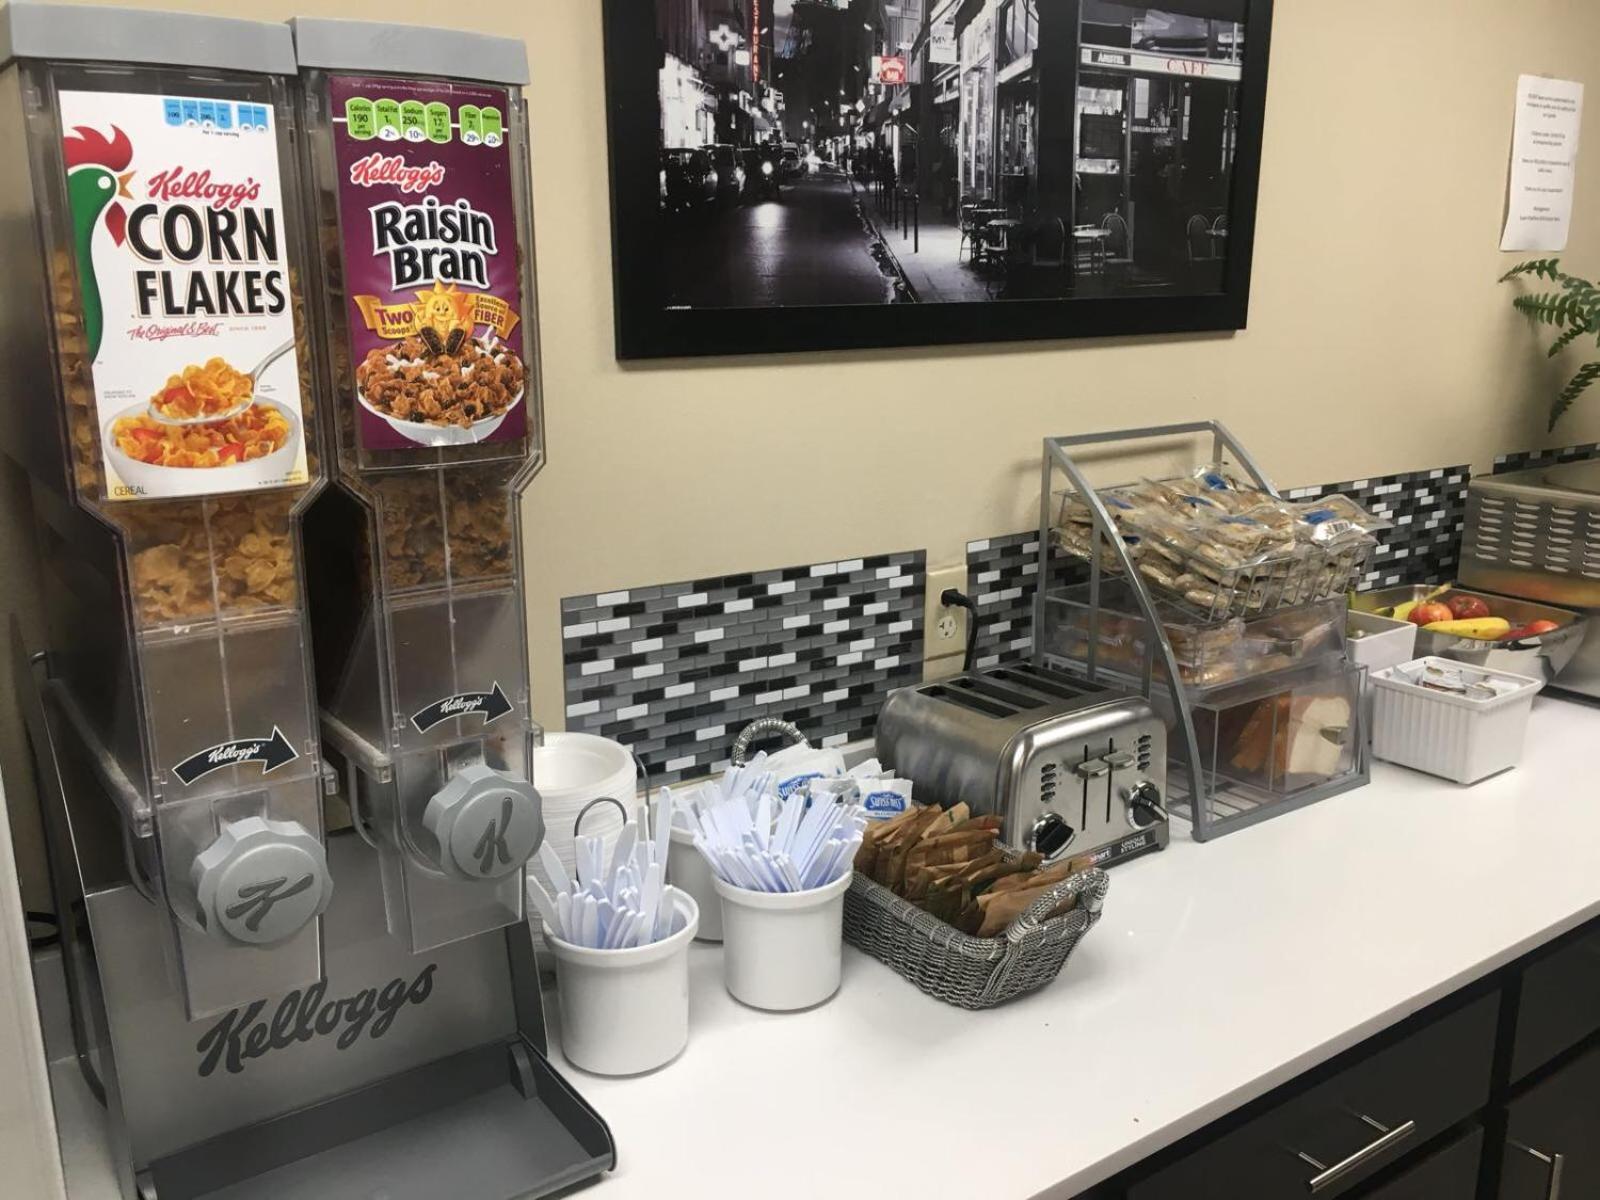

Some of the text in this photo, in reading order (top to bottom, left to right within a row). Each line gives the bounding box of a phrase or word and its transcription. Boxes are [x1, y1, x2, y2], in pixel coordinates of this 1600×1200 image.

[352, 114, 369, 122] 190
[148, 165, 261, 210] Kellogg's
[351, 154, 444, 192] Kellogg's
[127, 203, 279, 263] CORN
[371, 197, 497, 252] Raisin
[392, 245, 490, 289] Bran
[134, 270, 286, 316] FLAKES
[127, 325, 147, 340] The
[145, 323, 187, 341] Original
[474, 308, 505, 327] FIBER
[114, 485, 148, 496] CEREAL
[440, 696, 484, 713] Kellogg's
[208, 743, 261, 763] Kellogg's
